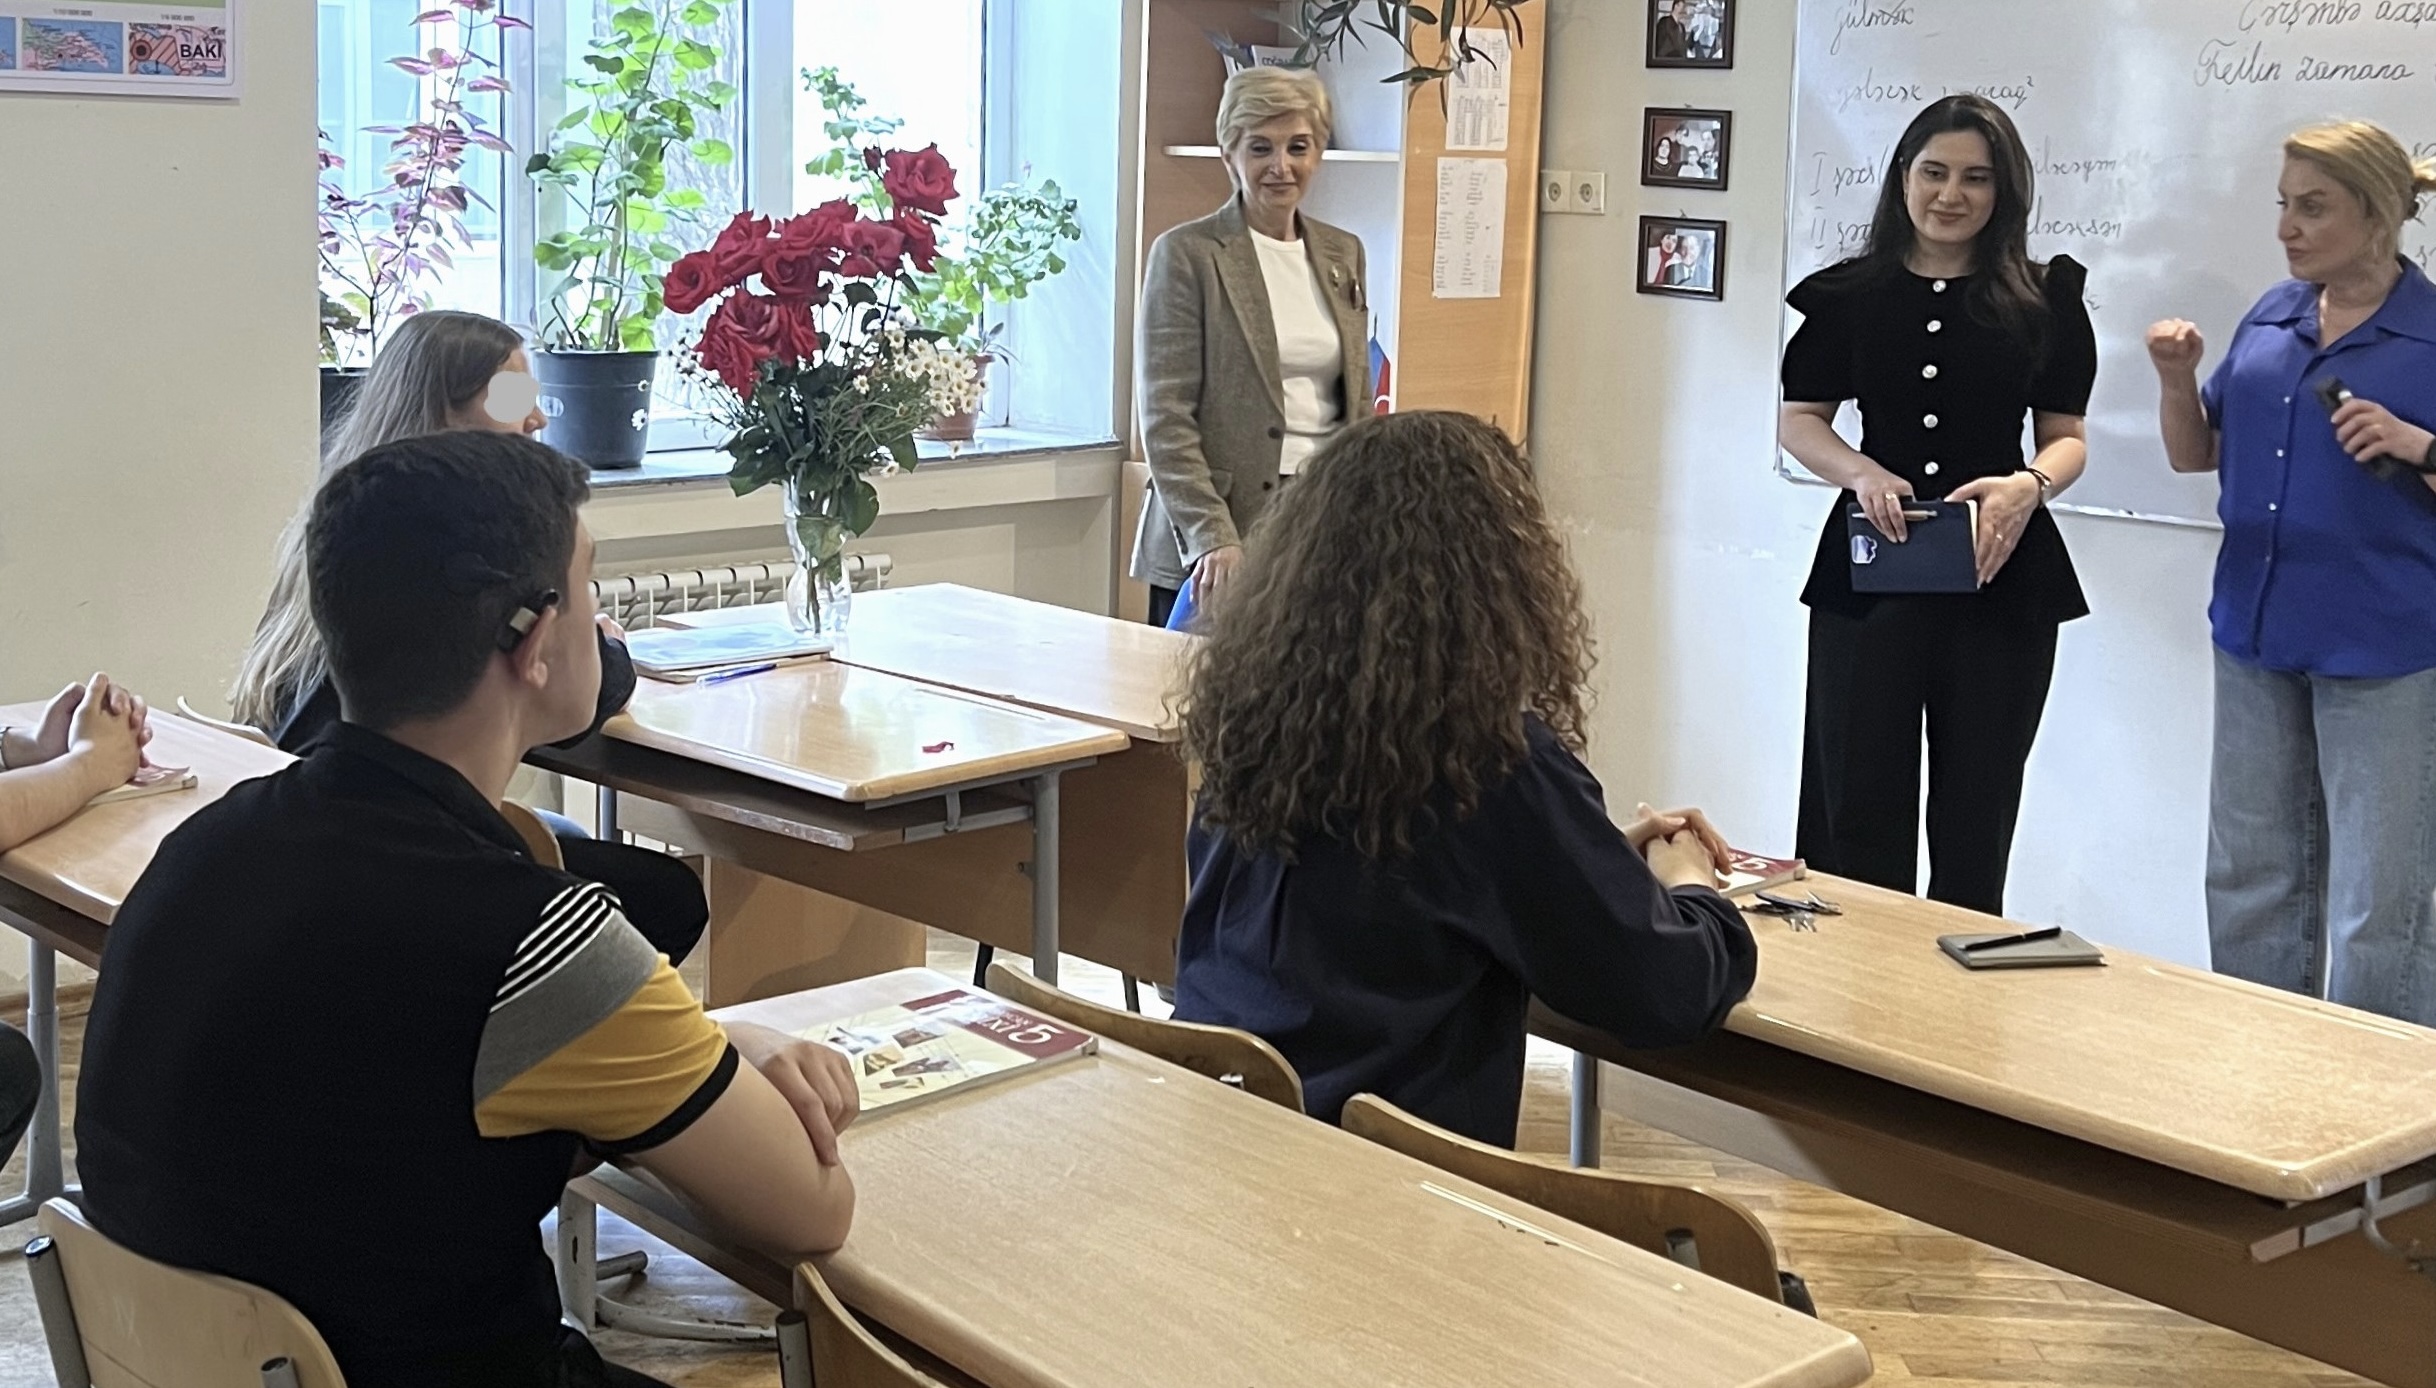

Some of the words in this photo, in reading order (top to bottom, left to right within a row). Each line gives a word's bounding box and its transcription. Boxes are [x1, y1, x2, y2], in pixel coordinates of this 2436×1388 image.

[180, 43, 222, 58] BAKI
[2296, 56, 2415, 81] zamana
[1008, 1024, 1065, 1044] 5
